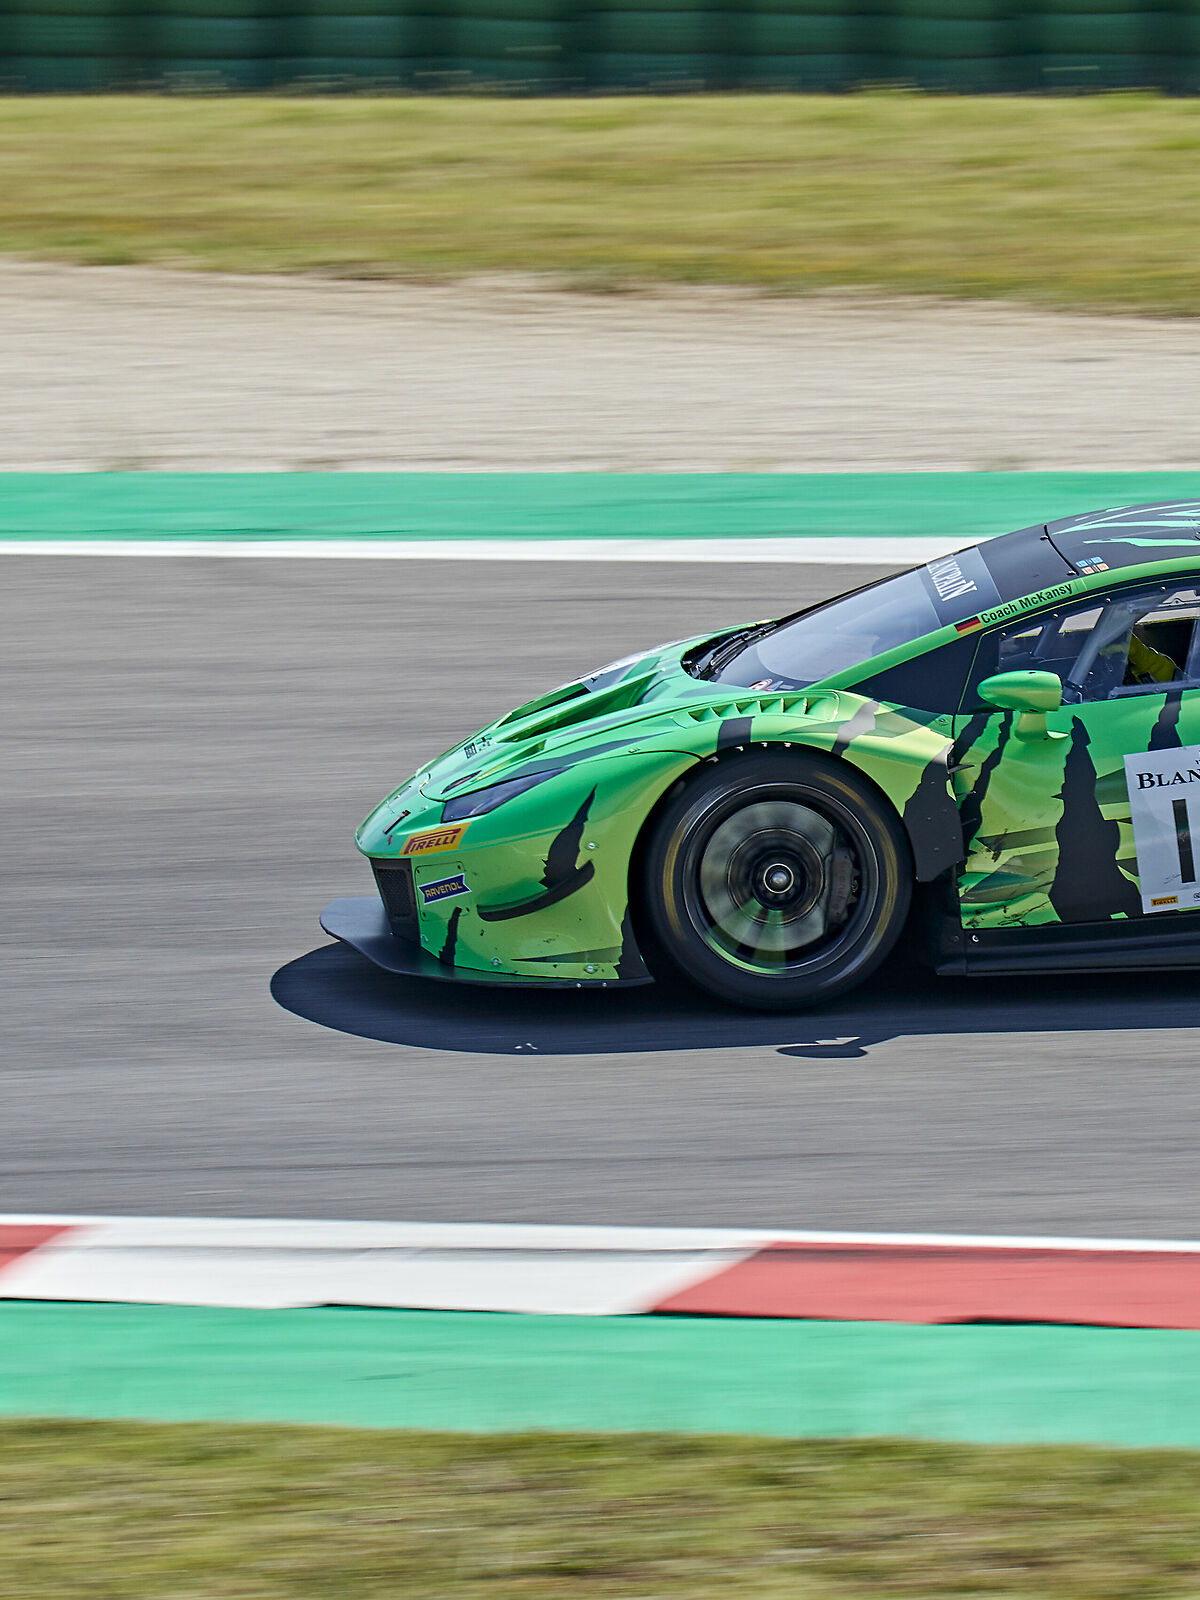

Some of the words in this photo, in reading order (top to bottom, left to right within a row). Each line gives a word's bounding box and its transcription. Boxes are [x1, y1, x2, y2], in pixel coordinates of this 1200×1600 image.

[980, 603, 1018, 624] Coach
[1019, 583, 1073, 609] McKansy
[403, 827, 462, 855] PIRELLI
[424, 881, 463, 898] RAVENOL
